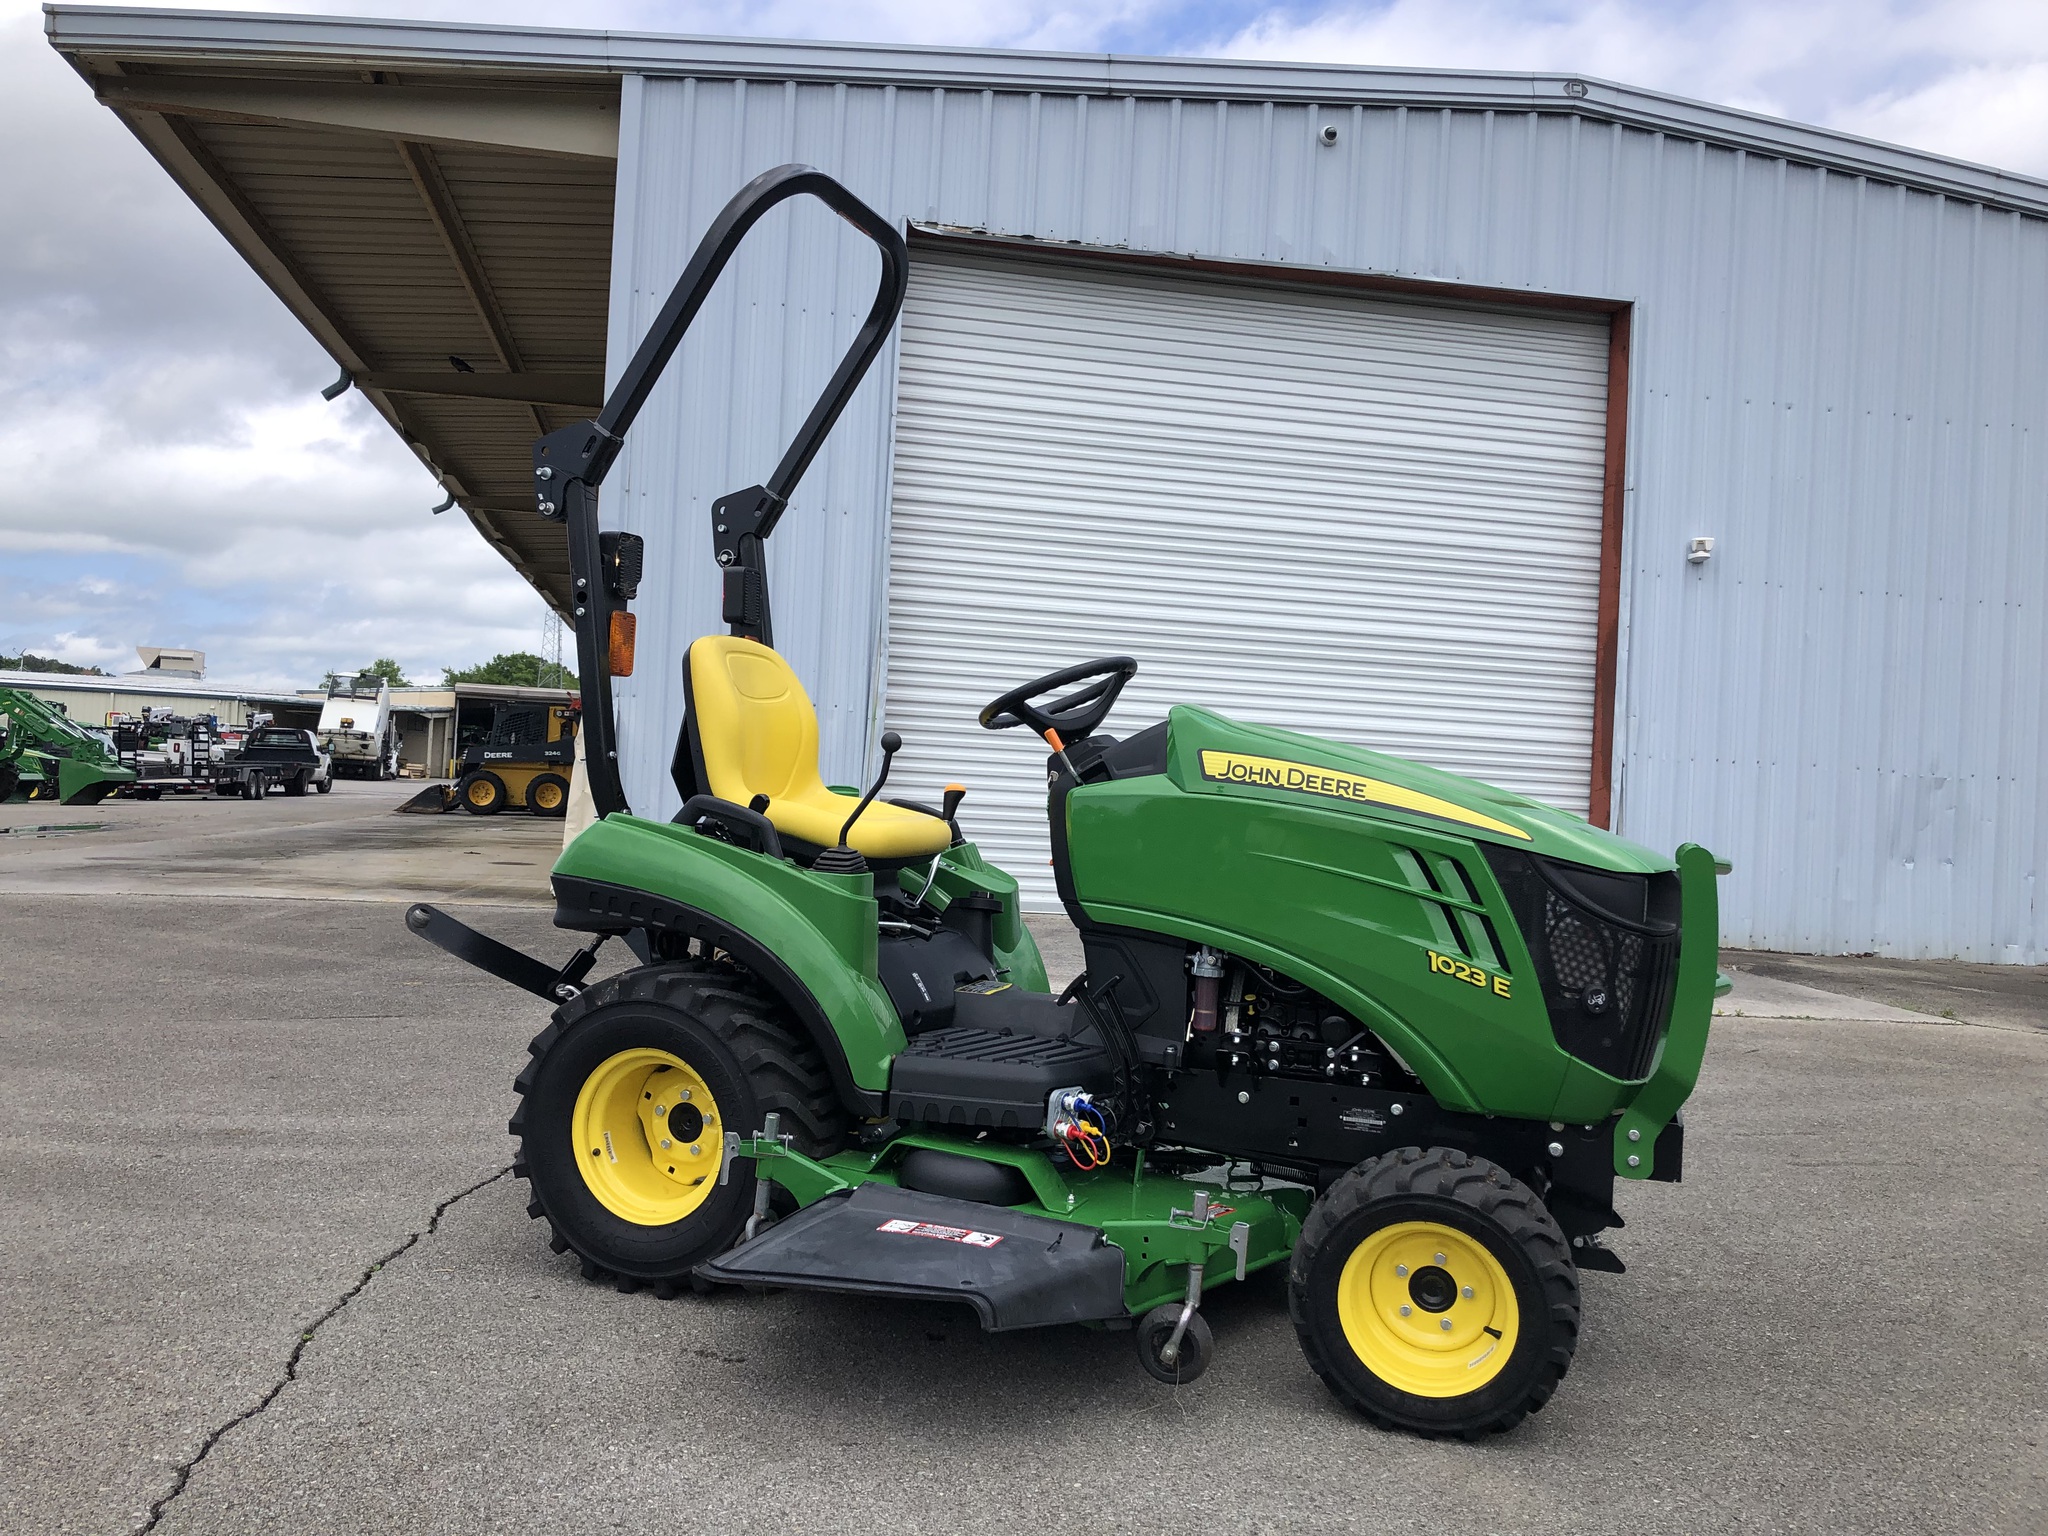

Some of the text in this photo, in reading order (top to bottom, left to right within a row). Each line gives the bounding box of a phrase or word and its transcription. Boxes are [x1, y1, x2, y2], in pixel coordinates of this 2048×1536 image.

[484, 751, 513, 759] DEERE
[1217, 760, 1367, 799] JOHN DEERE
[1426, 950, 1511, 999] 1023 E
